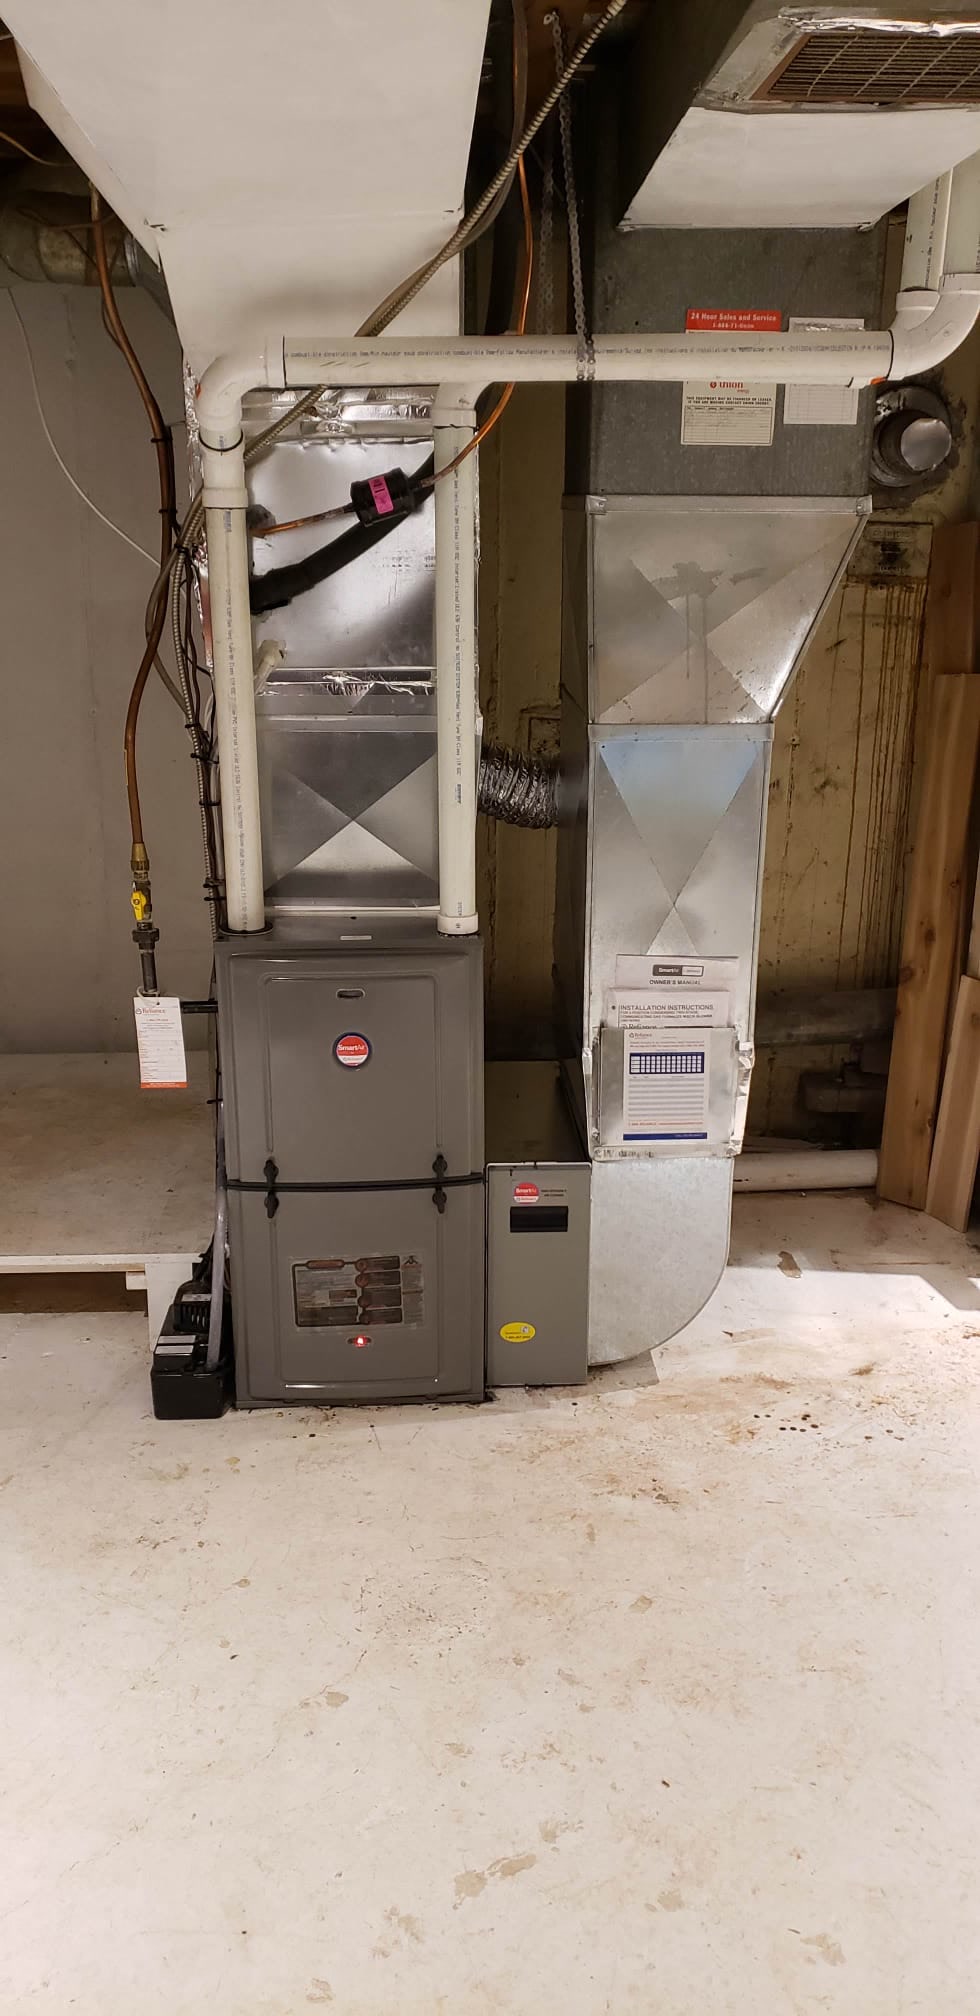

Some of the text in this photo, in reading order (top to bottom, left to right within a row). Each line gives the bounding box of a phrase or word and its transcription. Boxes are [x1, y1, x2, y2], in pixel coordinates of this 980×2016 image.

[690, 312, 777, 322] 24 Hour Sales and Service
